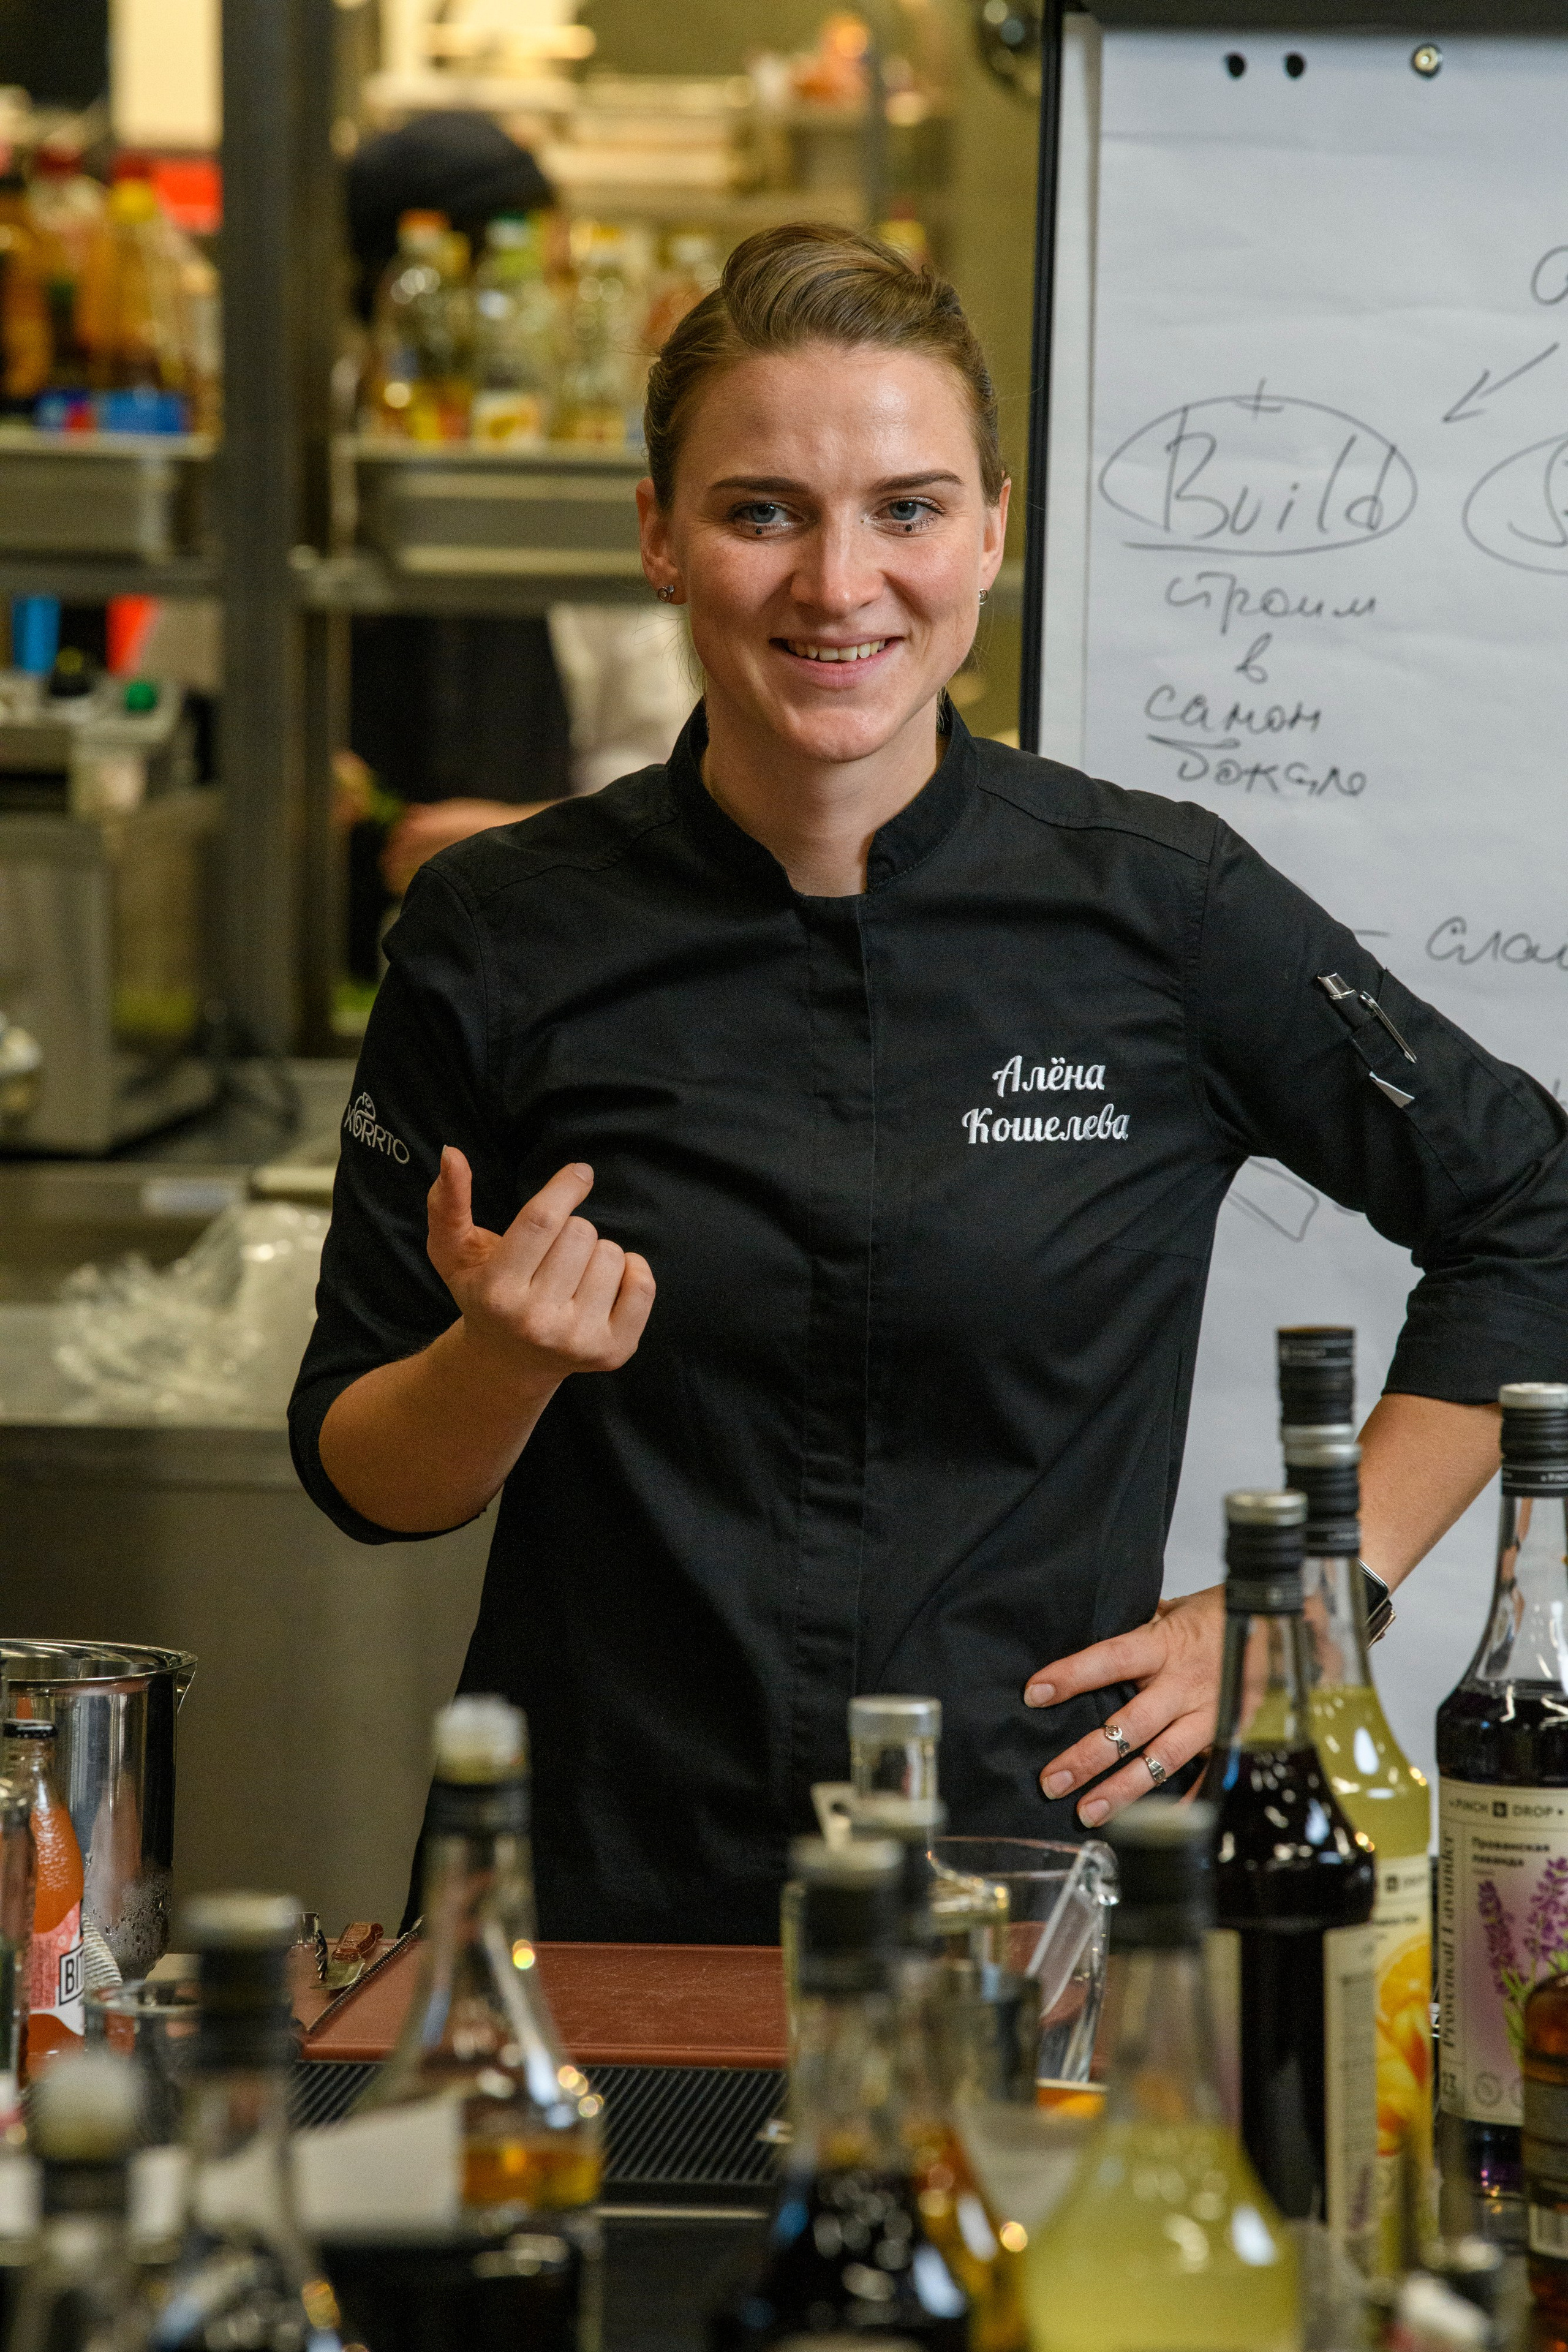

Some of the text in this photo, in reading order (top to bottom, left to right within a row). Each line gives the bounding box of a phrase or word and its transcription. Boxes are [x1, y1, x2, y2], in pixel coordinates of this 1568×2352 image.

[1165, 404, 1397, 540] Build
[1164, 570, 1378, 636] строим
[1234, 631, 1273, 685] в
[992, 1055, 1106, 1098] Алёна
[961, 1103, 1131, 1144] Кошелева
